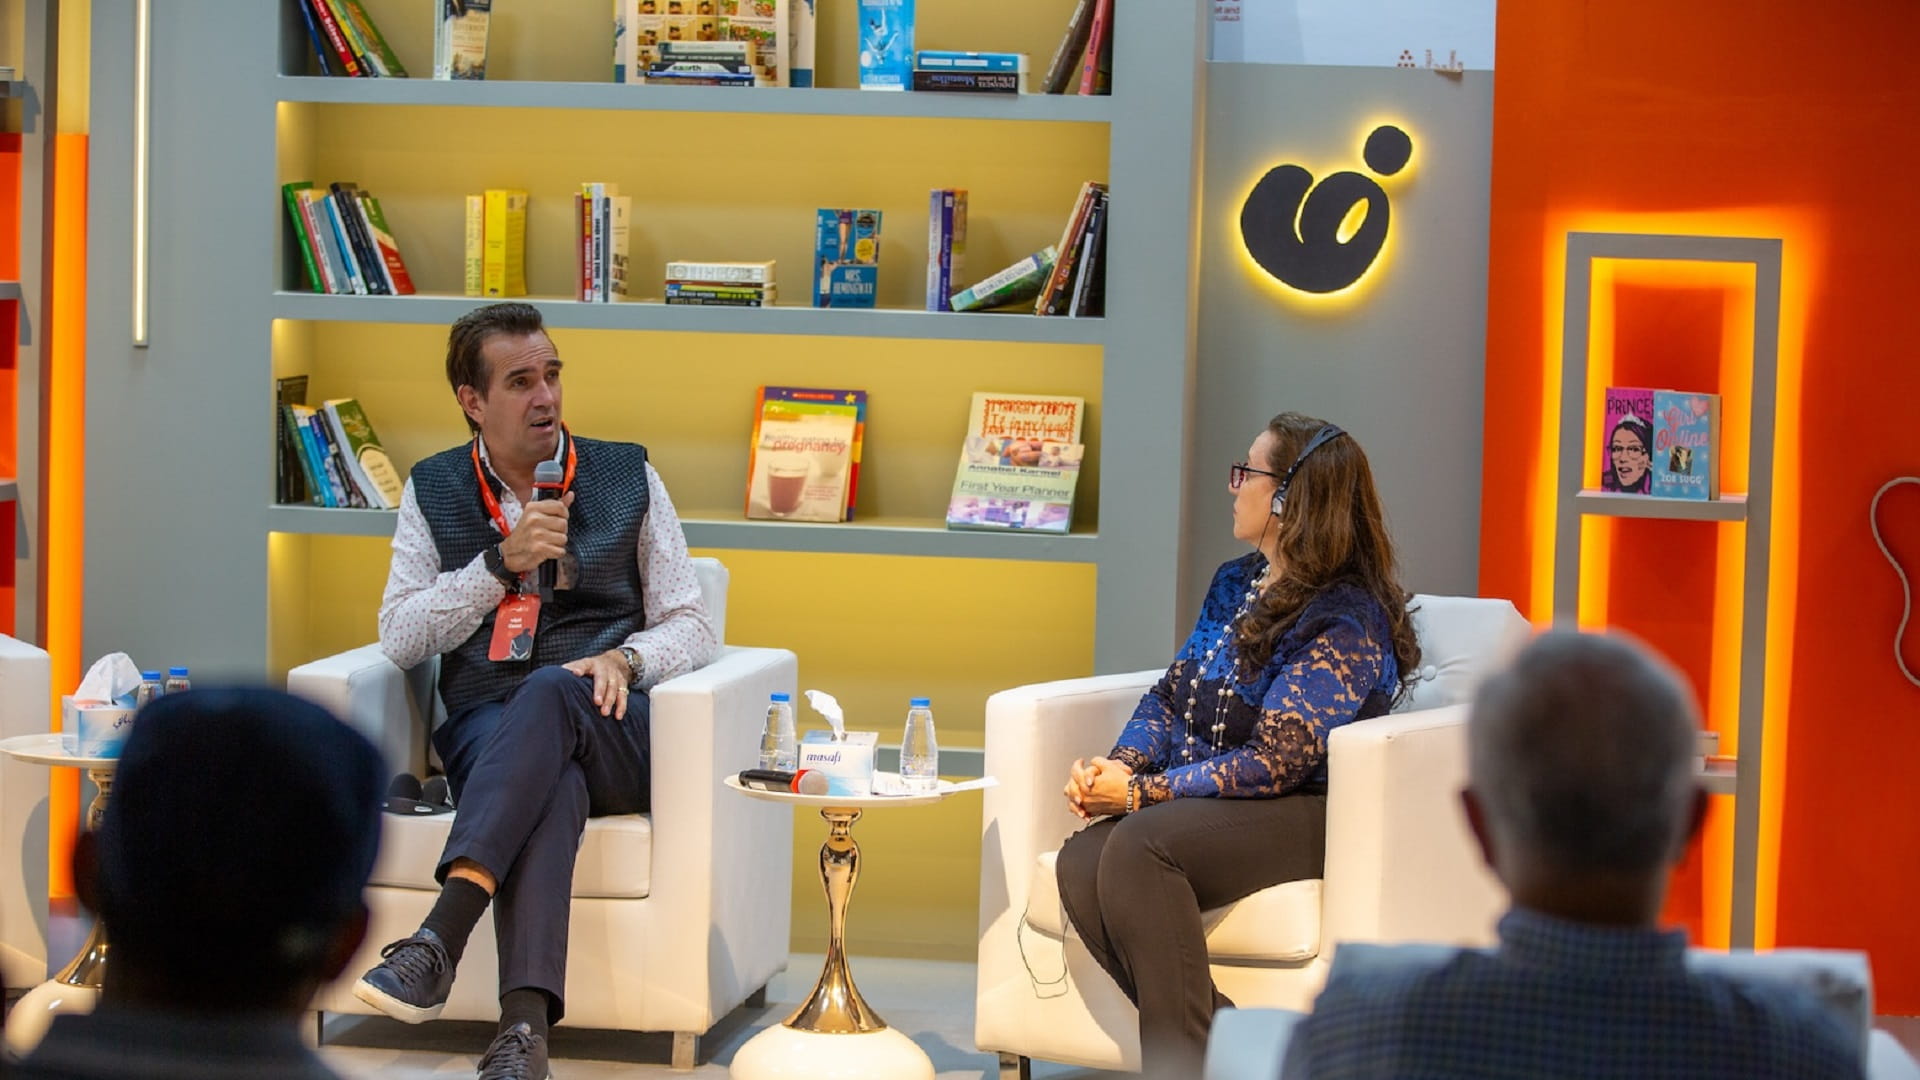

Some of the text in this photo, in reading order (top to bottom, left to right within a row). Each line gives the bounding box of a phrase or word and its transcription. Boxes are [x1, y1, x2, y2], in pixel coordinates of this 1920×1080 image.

[772, 440, 847, 456] pregnancy
[1656, 428, 1708, 452] Online
[968, 464, 1061, 476] Annabel Karmel
[960, 480, 1070, 497] First Year Planner
[806, 751, 842, 766] masafi
